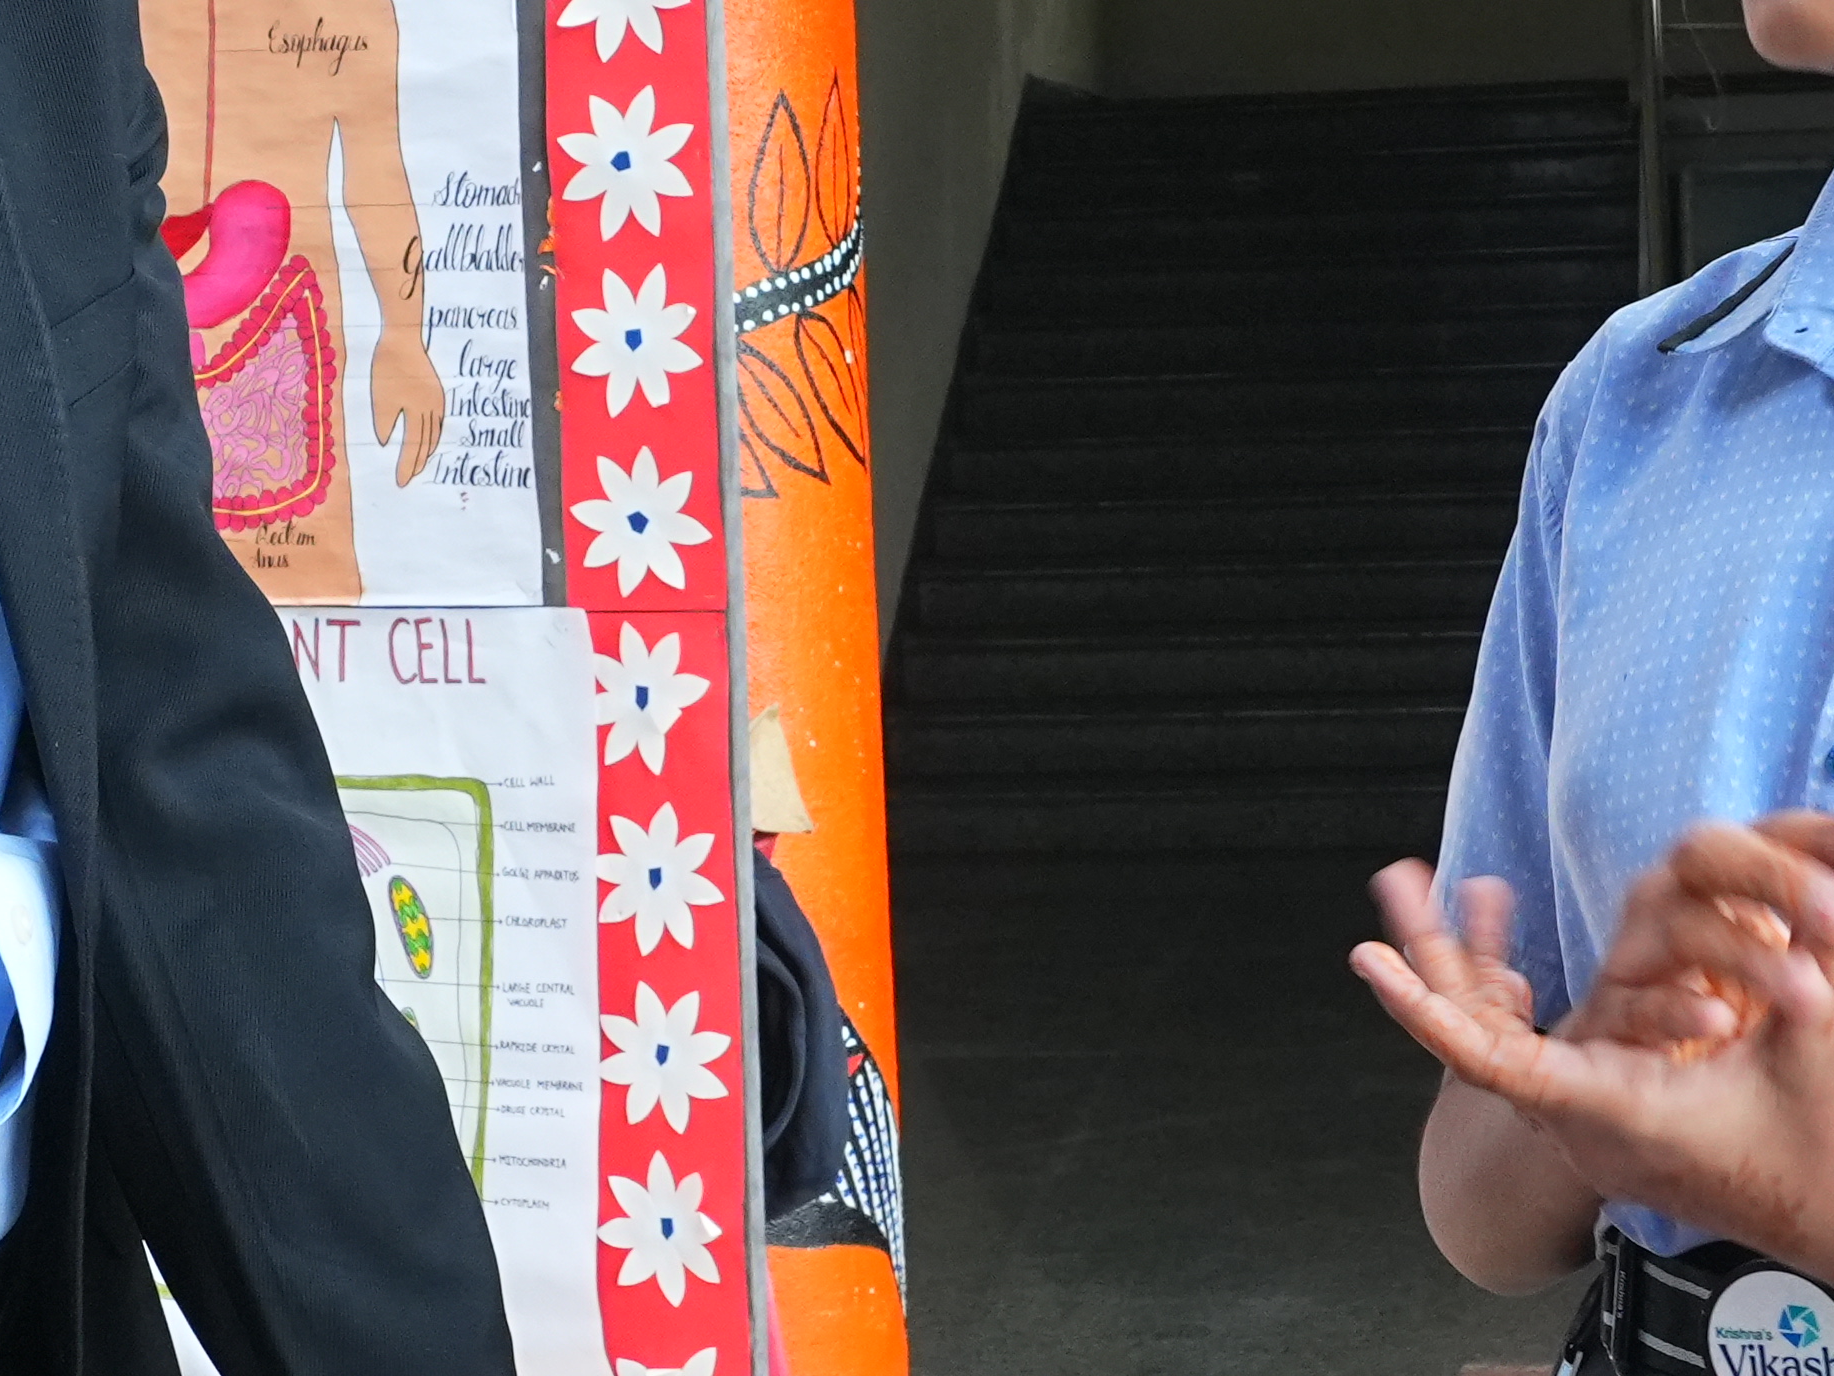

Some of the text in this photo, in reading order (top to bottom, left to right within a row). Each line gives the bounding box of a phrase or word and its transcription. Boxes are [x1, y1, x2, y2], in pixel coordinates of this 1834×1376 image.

[267, 16, 368, 77] Esophagus
[433, 171, 521, 208] Stomach
[425, 450, 532, 488] Intestine
[388, 617, 486, 684] CELL
[503, 774, 555, 788] CELL WALL
[503, 821, 576, 833] CELL MEMBRANE
[536, 982, 575, 995] CENTRAL
[1715, 1326, 1773, 1341] Krishna's
